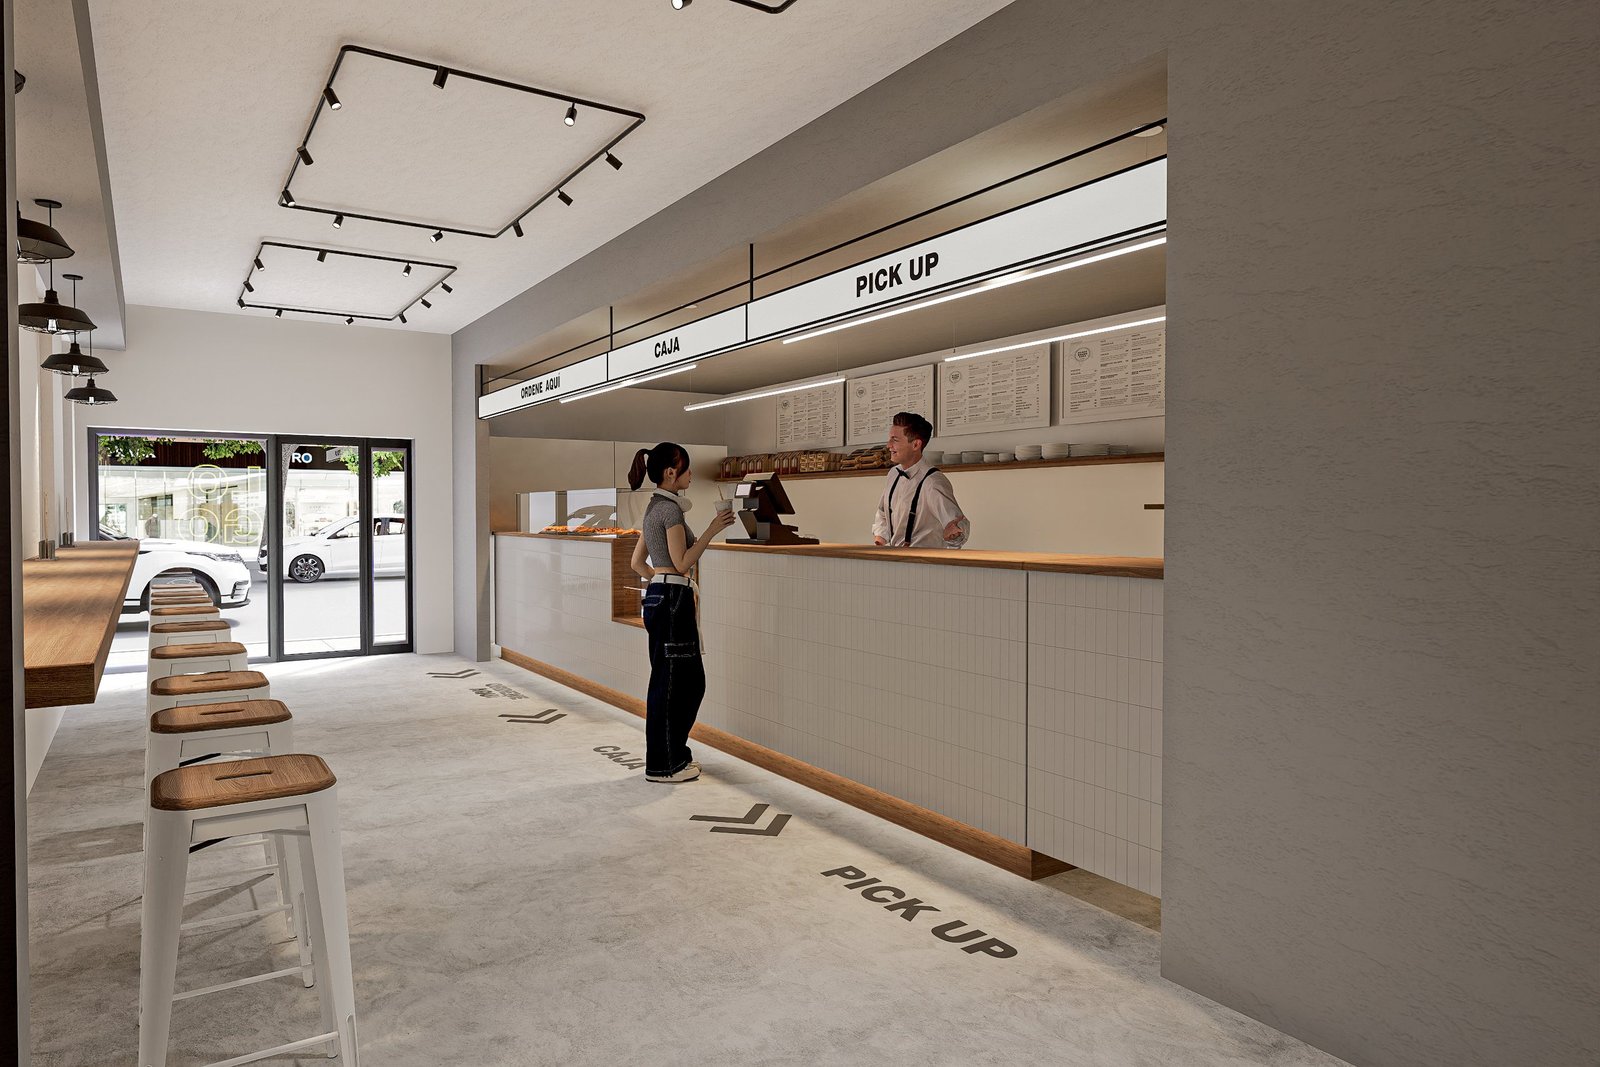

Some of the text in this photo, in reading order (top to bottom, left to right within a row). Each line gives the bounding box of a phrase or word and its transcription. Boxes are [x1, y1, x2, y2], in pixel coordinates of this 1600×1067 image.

[856, 252, 939, 298] PICK UP
[654, 336, 680, 358] CAJA
[520, 381, 543, 399] ORDENE
[593, 745, 647, 771] CAJA
[820, 865, 1018, 959] PICK UP
